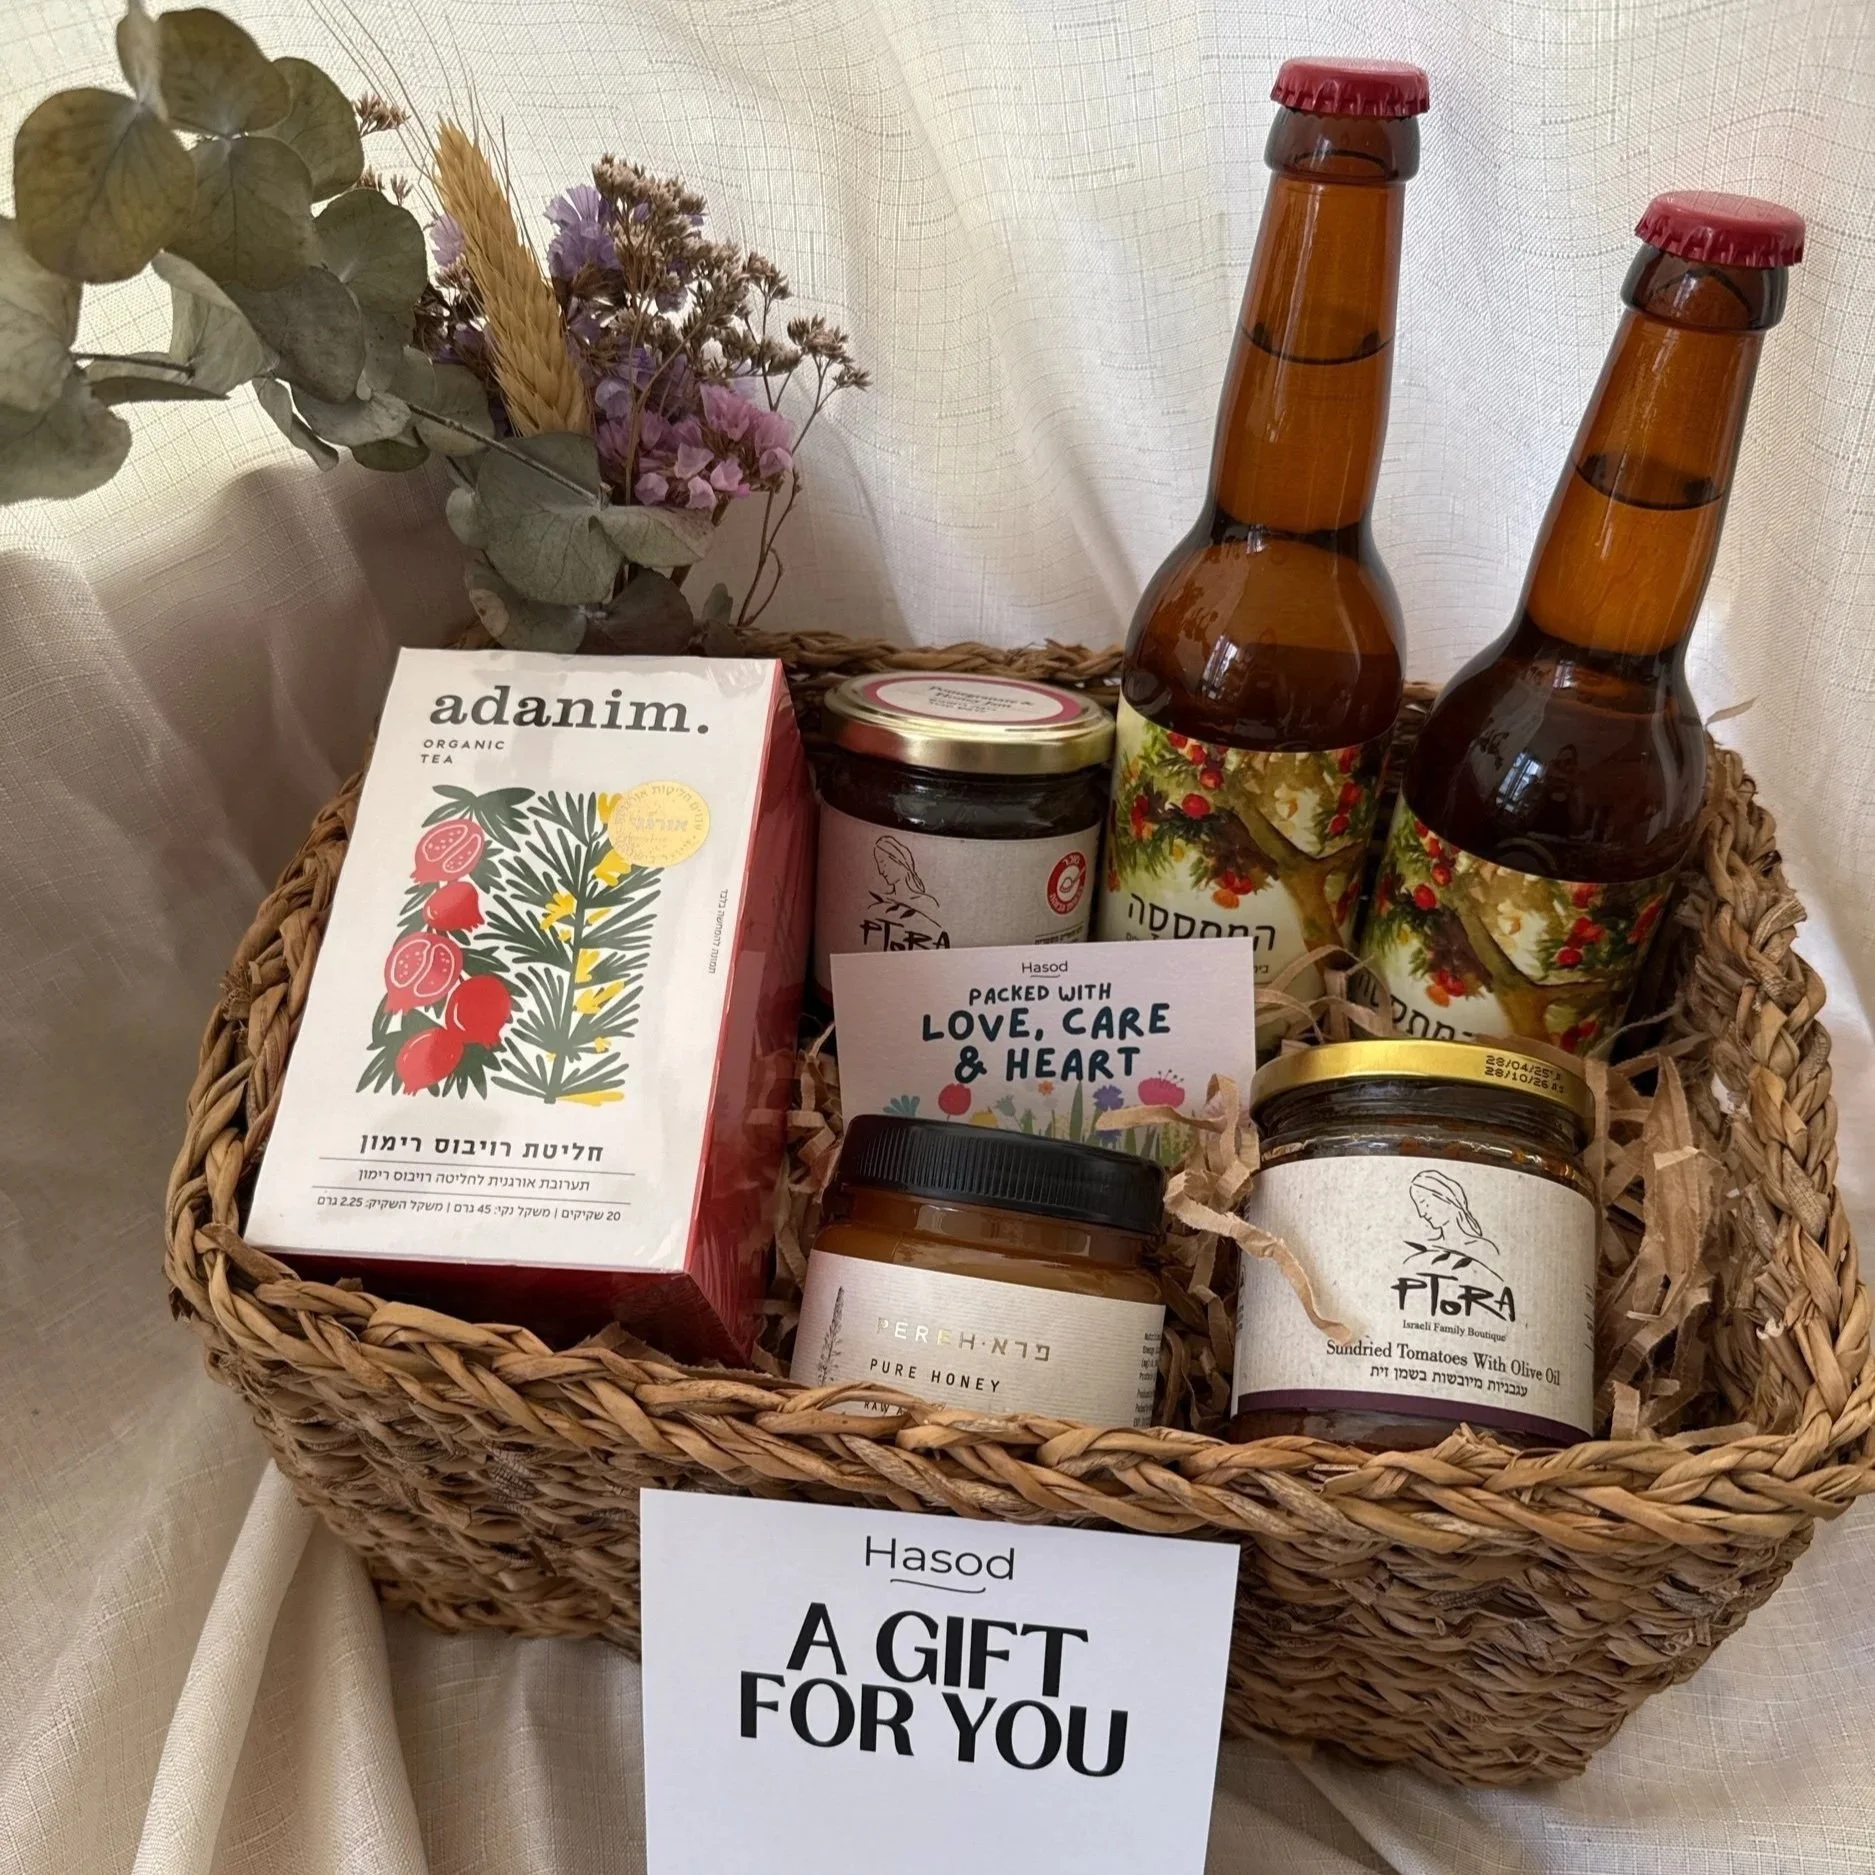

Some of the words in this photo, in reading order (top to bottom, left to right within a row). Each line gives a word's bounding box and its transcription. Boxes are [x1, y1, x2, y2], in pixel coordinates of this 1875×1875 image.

[423, 739, 505, 751] ORGANIC
[421, 754, 454, 765] TEA
[1021, 960, 1069, 974] Hasod
[969, 985, 1050, 1006] PACKED
[1058, 982, 1112, 1002] WITH
[921, 1007, 1044, 1042] LOVE,
[1062, 1002, 1172, 1041] CARE
[954, 1045, 988, 1084] &
[1005, 1046, 1142, 1083] HEART
[1485, 1055, 1549, 1079] 28/04/25
[1484, 1066, 1549, 1089] 28/10/26
[360, 1134, 422, 1155] רימון
[434, 1138, 512, 1157] רויבוס
[522, 1142, 604, 1162] חליטת
[358, 1168, 390, 1181] רימון
[393, 1170, 432, 1183] רויבוס
[435, 1172, 485, 1186] לחליטה
[487, 1175, 537, 1189] אורגנית
[538, 1177, 590, 1192] תערובת
[317, 1195, 338, 1206] גרם
[340, 1196, 363, 1207] 2.25
[410, 1200, 443, 1213] משקל
[453, 1202, 474, 1213] גרם
[477, 1204, 492, 1214] 45
[517, 1206, 551, 1218] משקל
[561, 1208, 604, 1222] שקיקים
[606, 1211, 621, 1221] 20
[1403, 1320, 1432, 1331] Israeli
[1433, 1322, 1465, 1337] Family
[1467, 1327, 1506, 1344] Boutique
[1326, 1339, 1392, 1357] Sundried
[1397, 1343, 1468, 1366] Tomatoes
[1473, 1352, 1506, 1373] With
[1511, 1359, 1543, 1381] Olive
[1546, 1368, 1560, 1386] Oil
[869, 1358, 918, 1380] PURE
[931, 1369, 1001, 1393] HONEY
[1370, 1365, 1389, 1378] זית
[1394, 1367, 1427, 1382] בשמן
[1431, 1371, 1483, 1389] מיובשות
[1488, 1379, 1528, 1398] עגבניות
[865, 1535, 1015, 1581] Hasod
[786, 1602, 847, 1676] A
[876, 1610, 1089, 1698] GIFT
[740, 1671, 914, 1757] FOR
[941, 1692, 1129, 1777] YOU
